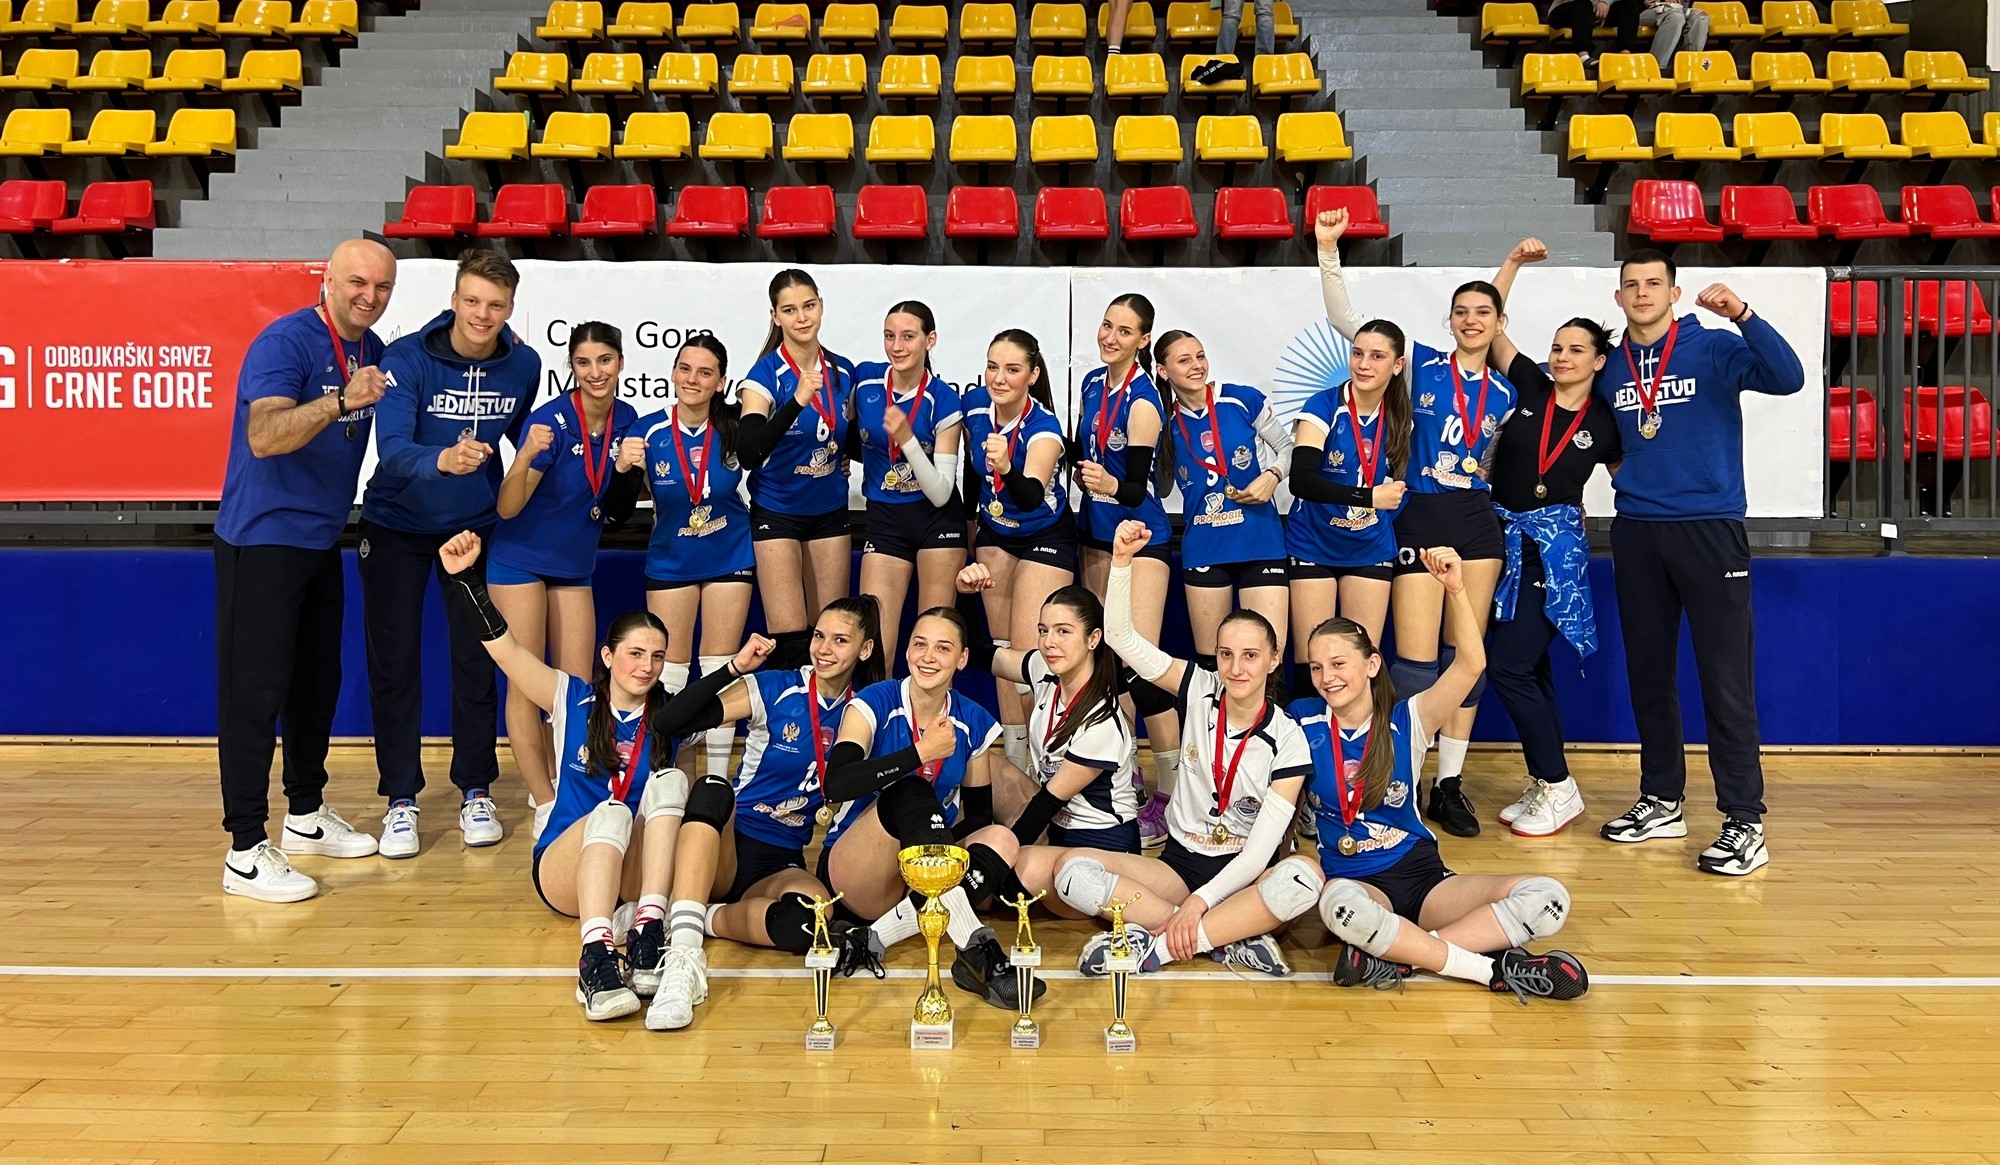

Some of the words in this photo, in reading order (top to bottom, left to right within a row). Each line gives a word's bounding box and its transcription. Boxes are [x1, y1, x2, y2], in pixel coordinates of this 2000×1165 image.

[45, 342, 154, 368] ODBOJKAŠKI
[159, 346, 213, 368] SAVEZ
[45, 372, 123, 409] CRNE
[133, 372, 213, 409] GORE
[816, 415, 830, 442] 6
[1440, 414, 1465, 446] 10
[1204, 456, 1219, 487] 3
[1194, 510, 1244, 524] PROMOBIL
[1183, 831, 1243, 846] PROMBIL
